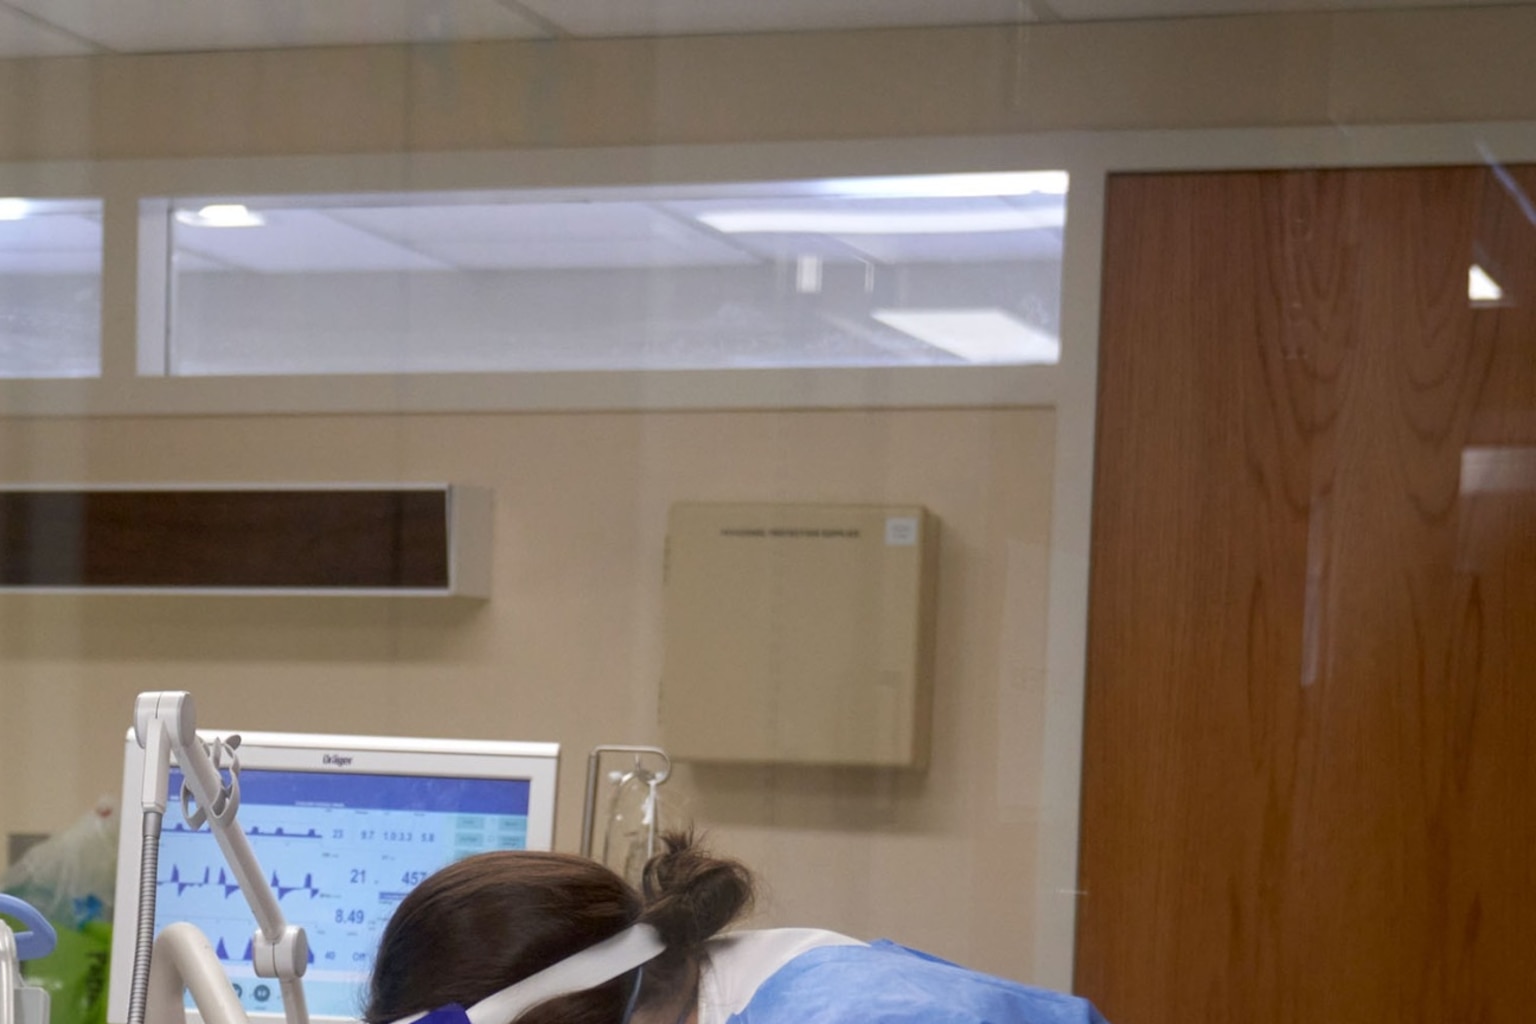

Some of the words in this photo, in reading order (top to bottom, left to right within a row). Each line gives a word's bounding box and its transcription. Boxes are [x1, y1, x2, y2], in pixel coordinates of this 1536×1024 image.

[322, 754, 352, 766] Dräger
[350, 869, 366, 884] 21
[334, 908, 364, 924] 8.49
